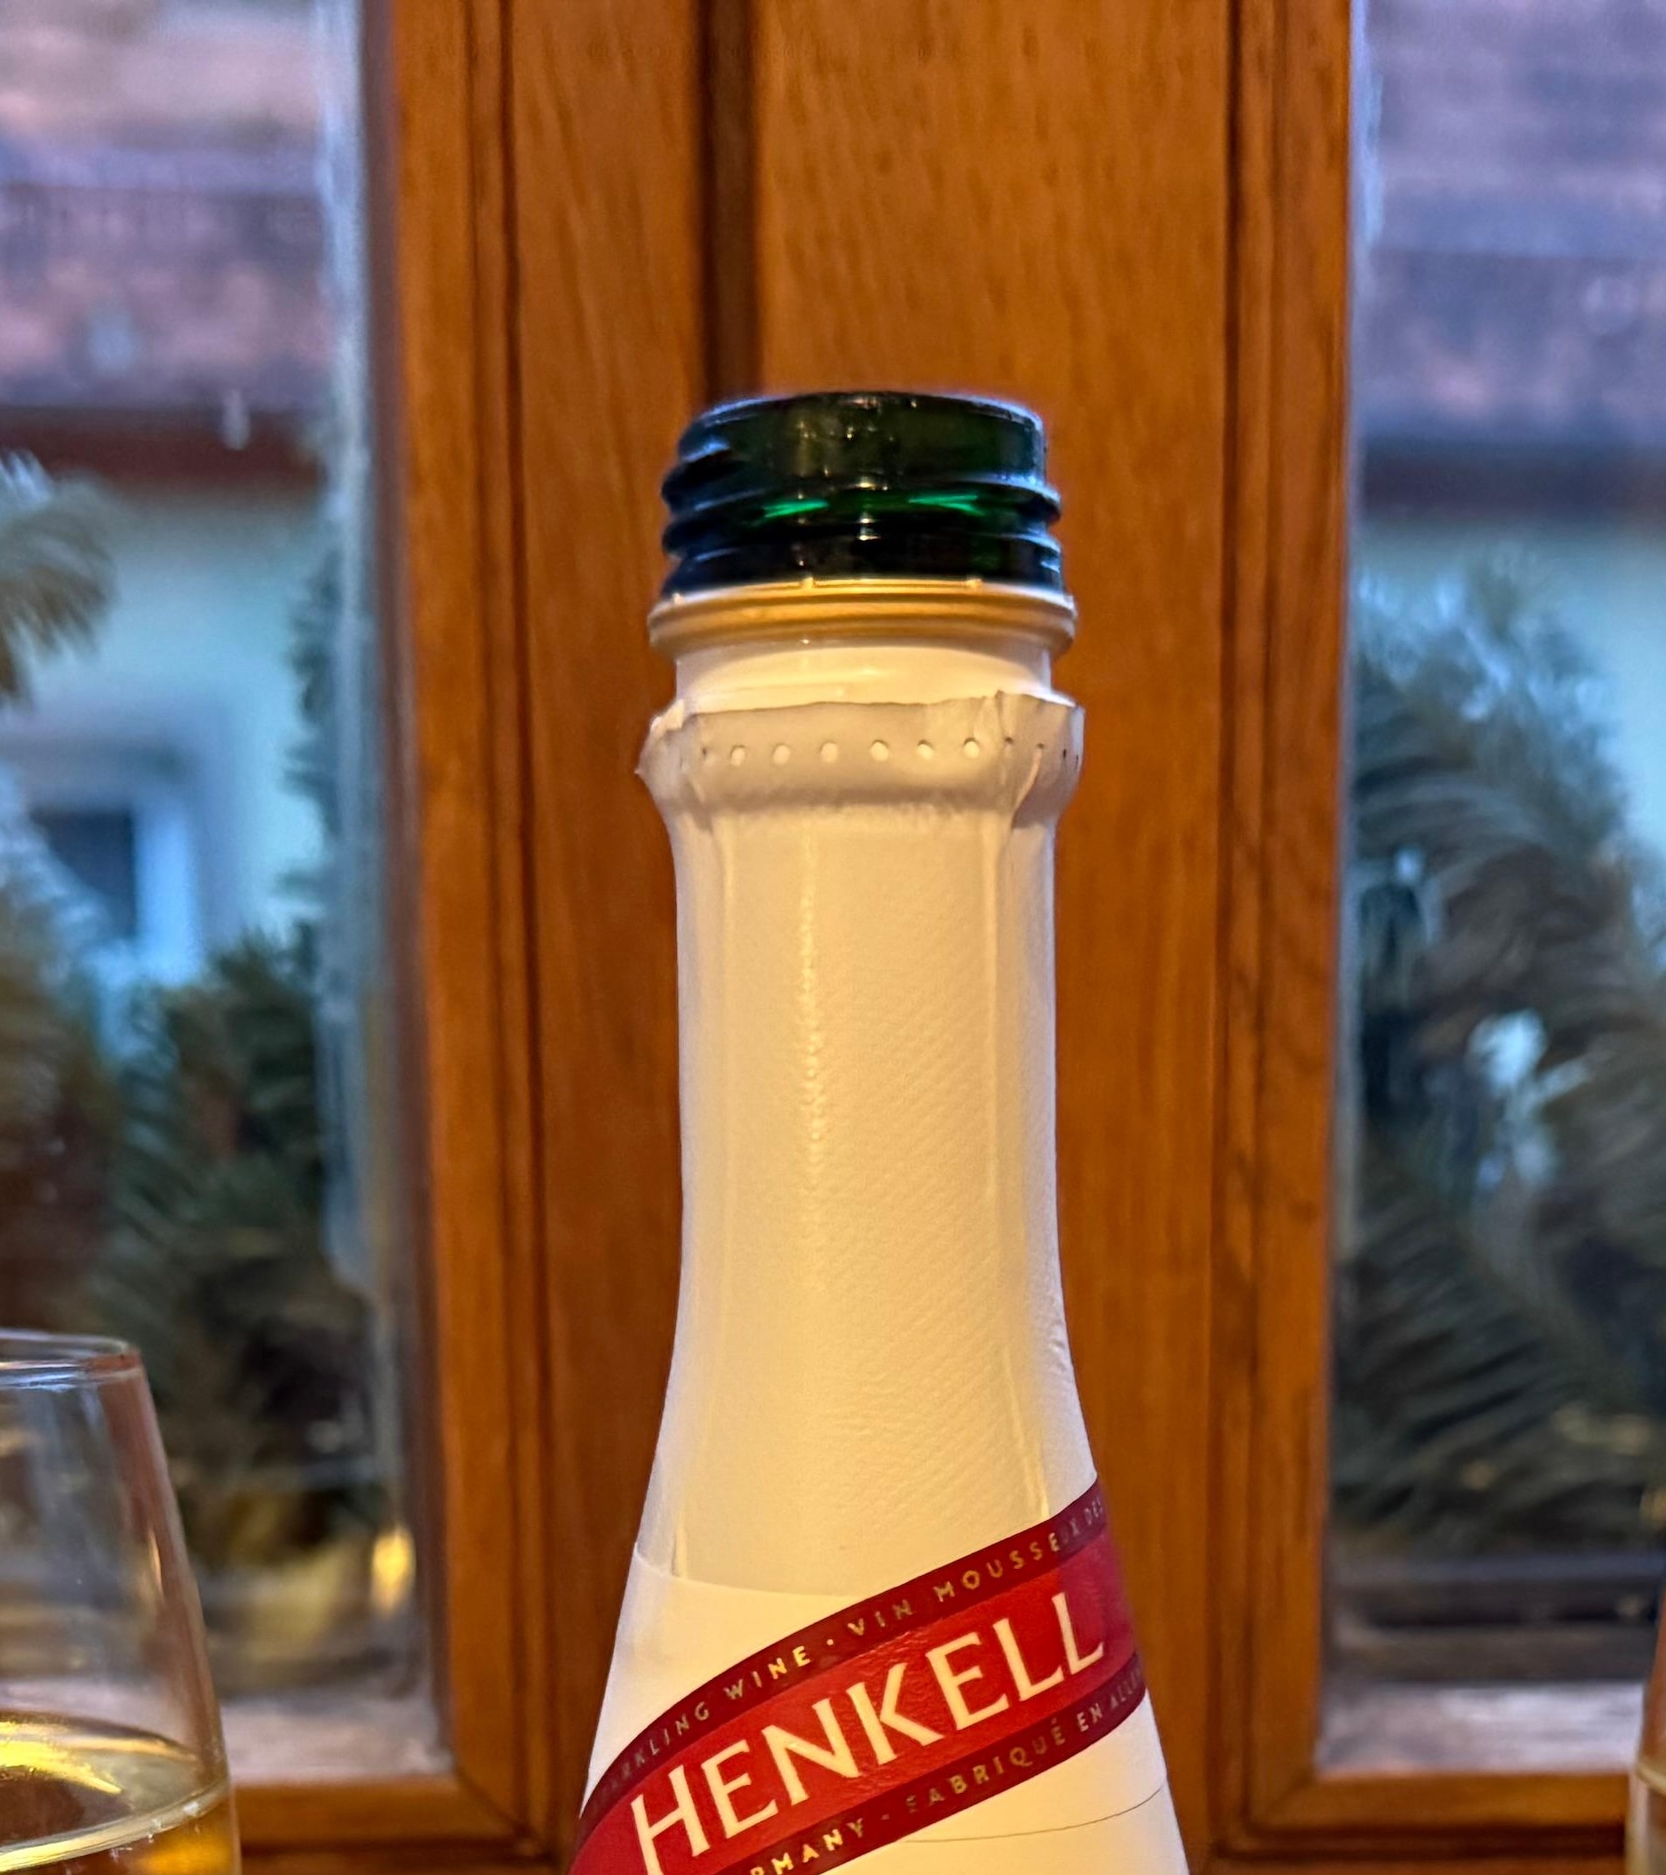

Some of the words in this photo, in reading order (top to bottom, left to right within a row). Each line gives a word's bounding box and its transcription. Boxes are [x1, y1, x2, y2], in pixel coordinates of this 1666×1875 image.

[723, 1644, 811, 1700] WINE
[847, 1599, 913, 1637] VIN
[1076, 1702, 1104, 1732] EN
